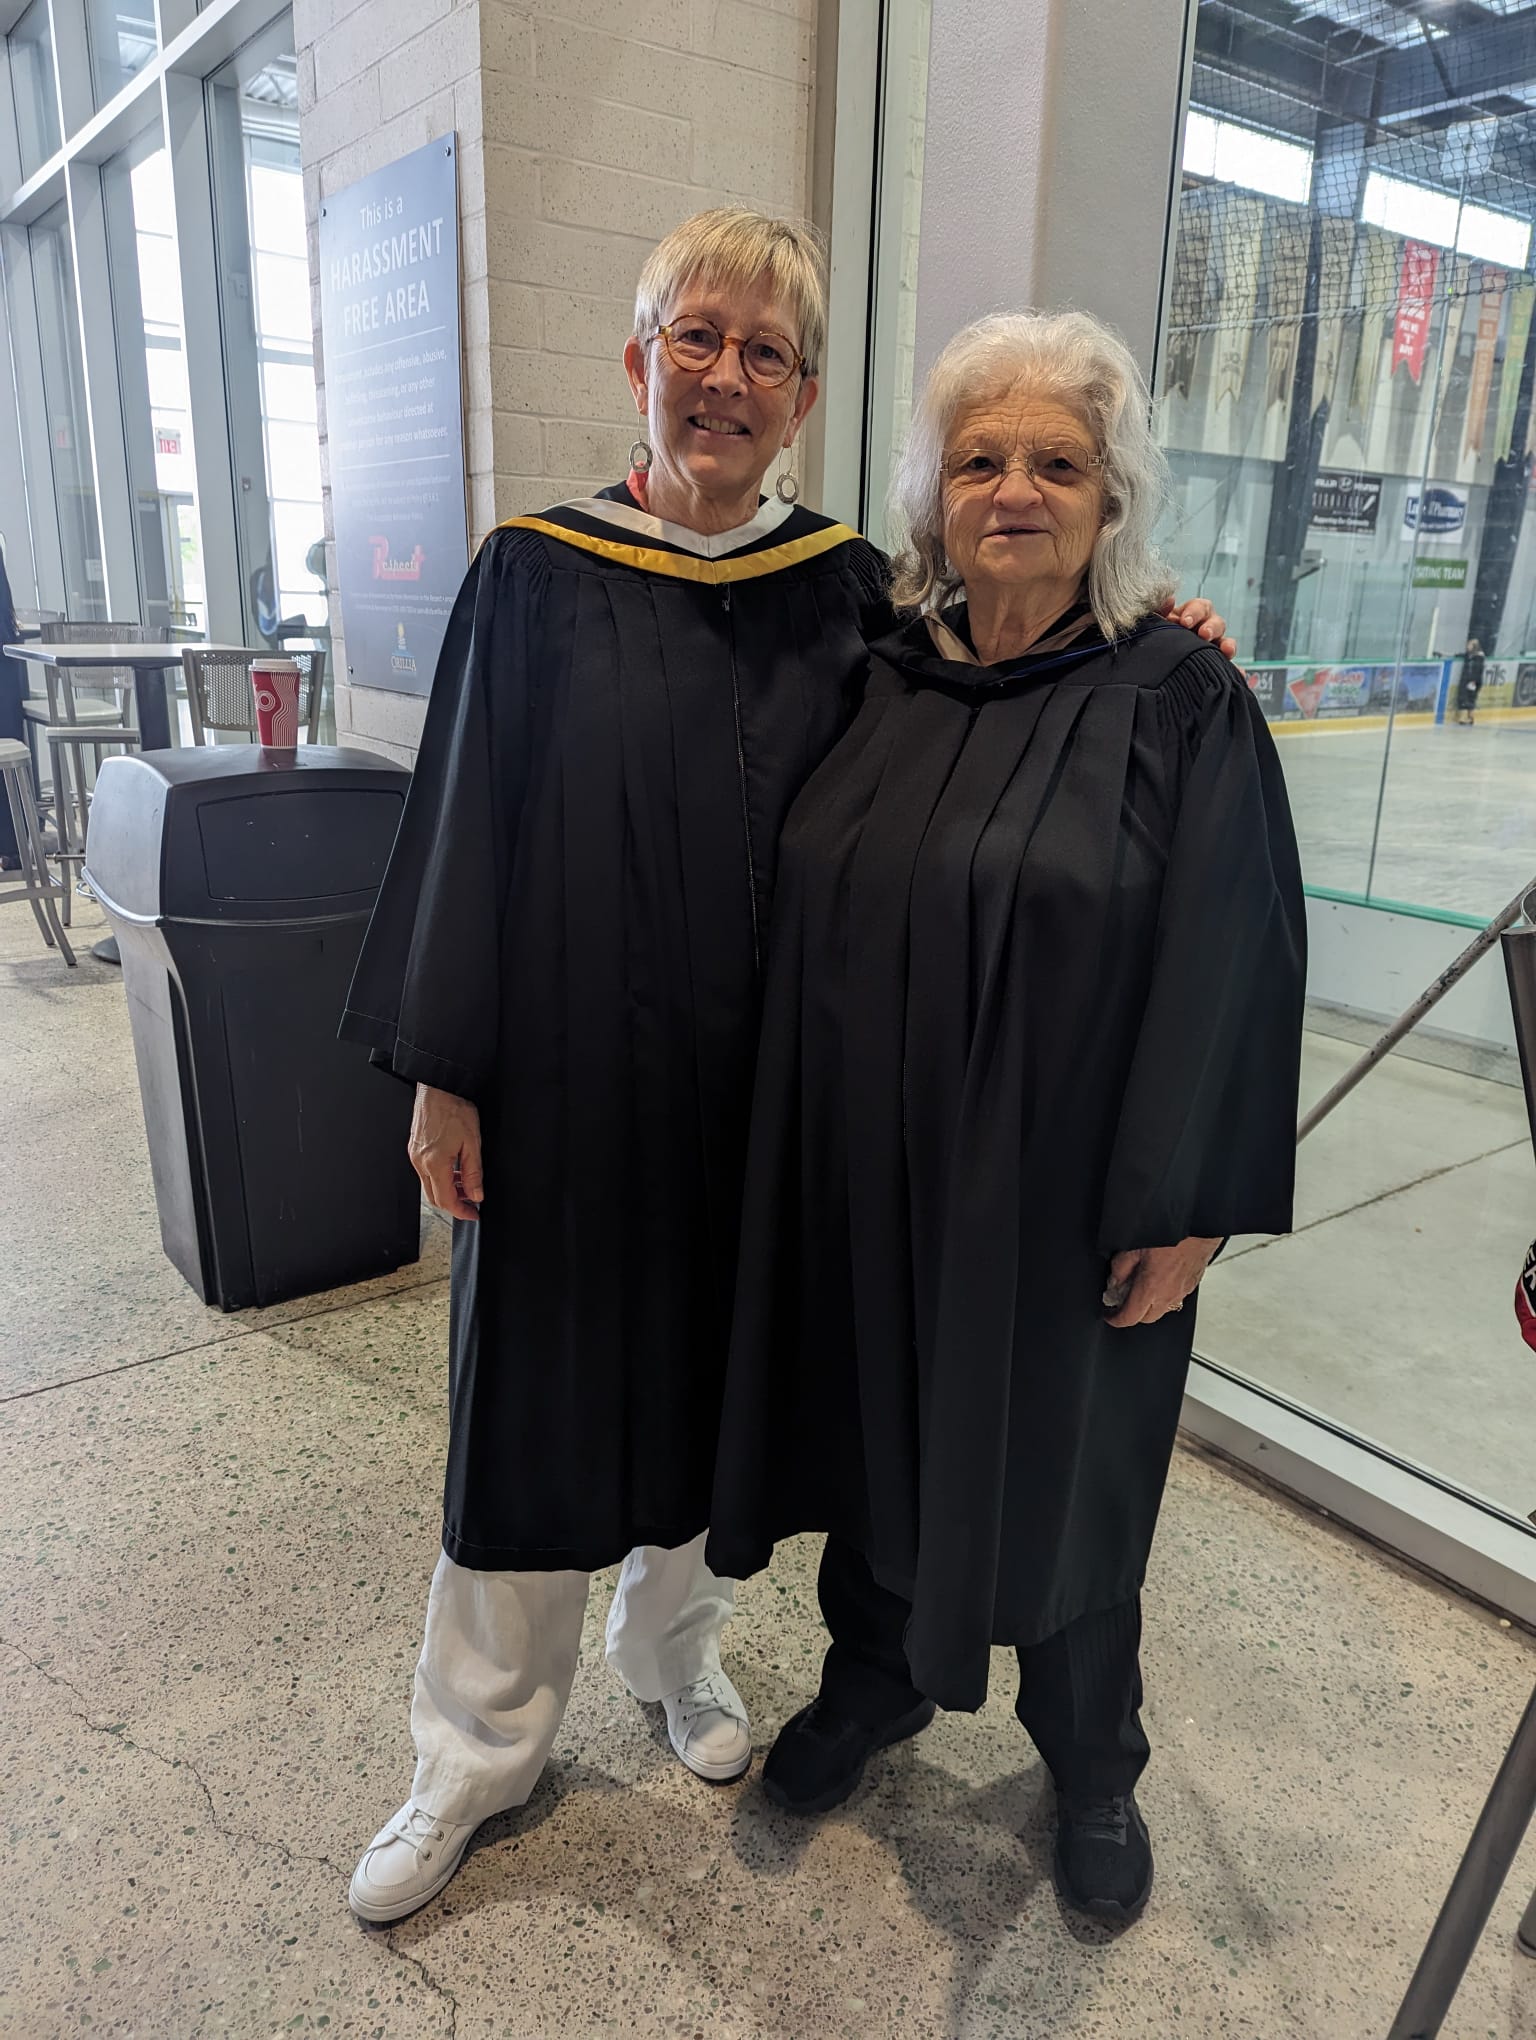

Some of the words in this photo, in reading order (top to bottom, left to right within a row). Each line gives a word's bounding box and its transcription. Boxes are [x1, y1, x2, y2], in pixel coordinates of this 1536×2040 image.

[359, 201, 382, 230] This
[384, 197, 393, 220] is
[396, 196, 403, 216] a
[330, 217, 444, 292] HARASSMENT
[343, 295, 380, 337] FREE
[384, 279, 430, 328] AREA
[1443, 567, 1465, 580] TEAM
